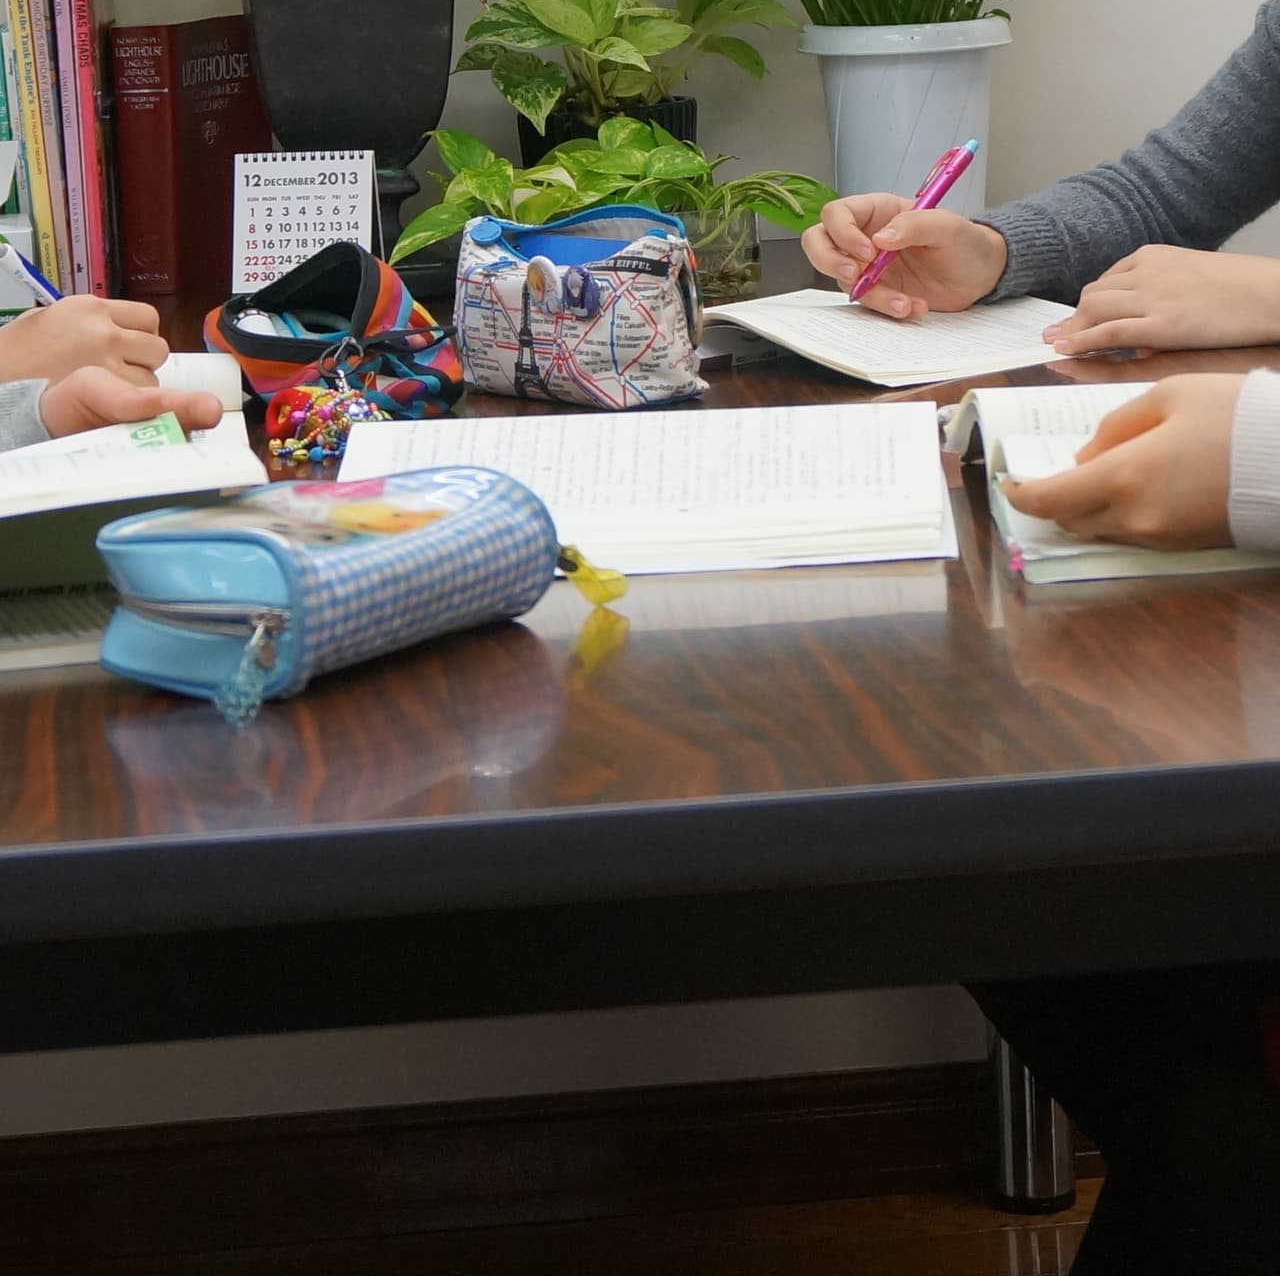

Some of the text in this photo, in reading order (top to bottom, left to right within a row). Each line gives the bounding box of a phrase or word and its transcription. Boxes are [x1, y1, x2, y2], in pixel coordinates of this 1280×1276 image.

[78, 32, 91, 69] CHAOS
[115, 45, 164, 58] LIGHTHOUSE
[181, 52, 249, 87] LIGHTHOUSE
[243, 171, 359, 188] 12 DECEMBER 2013
[265, 207, 273, 217] 2
[282, 206, 290, 216] 3
[298, 206, 306, 216] 4
[315, 206, 323, 215] 5
[332, 205, 340, 215] 6
[349, 205, 357, 215] 7
[248, 221, 359, 234] 8 9 10 11 12 13 14
[246, 238, 325, 250] 15 16 17 18 19
[244, 256, 259, 266] 22
[261, 256, 276, 265] 23
[278, 255, 293, 265] 24
[244, 272, 275, 282] 29 30
